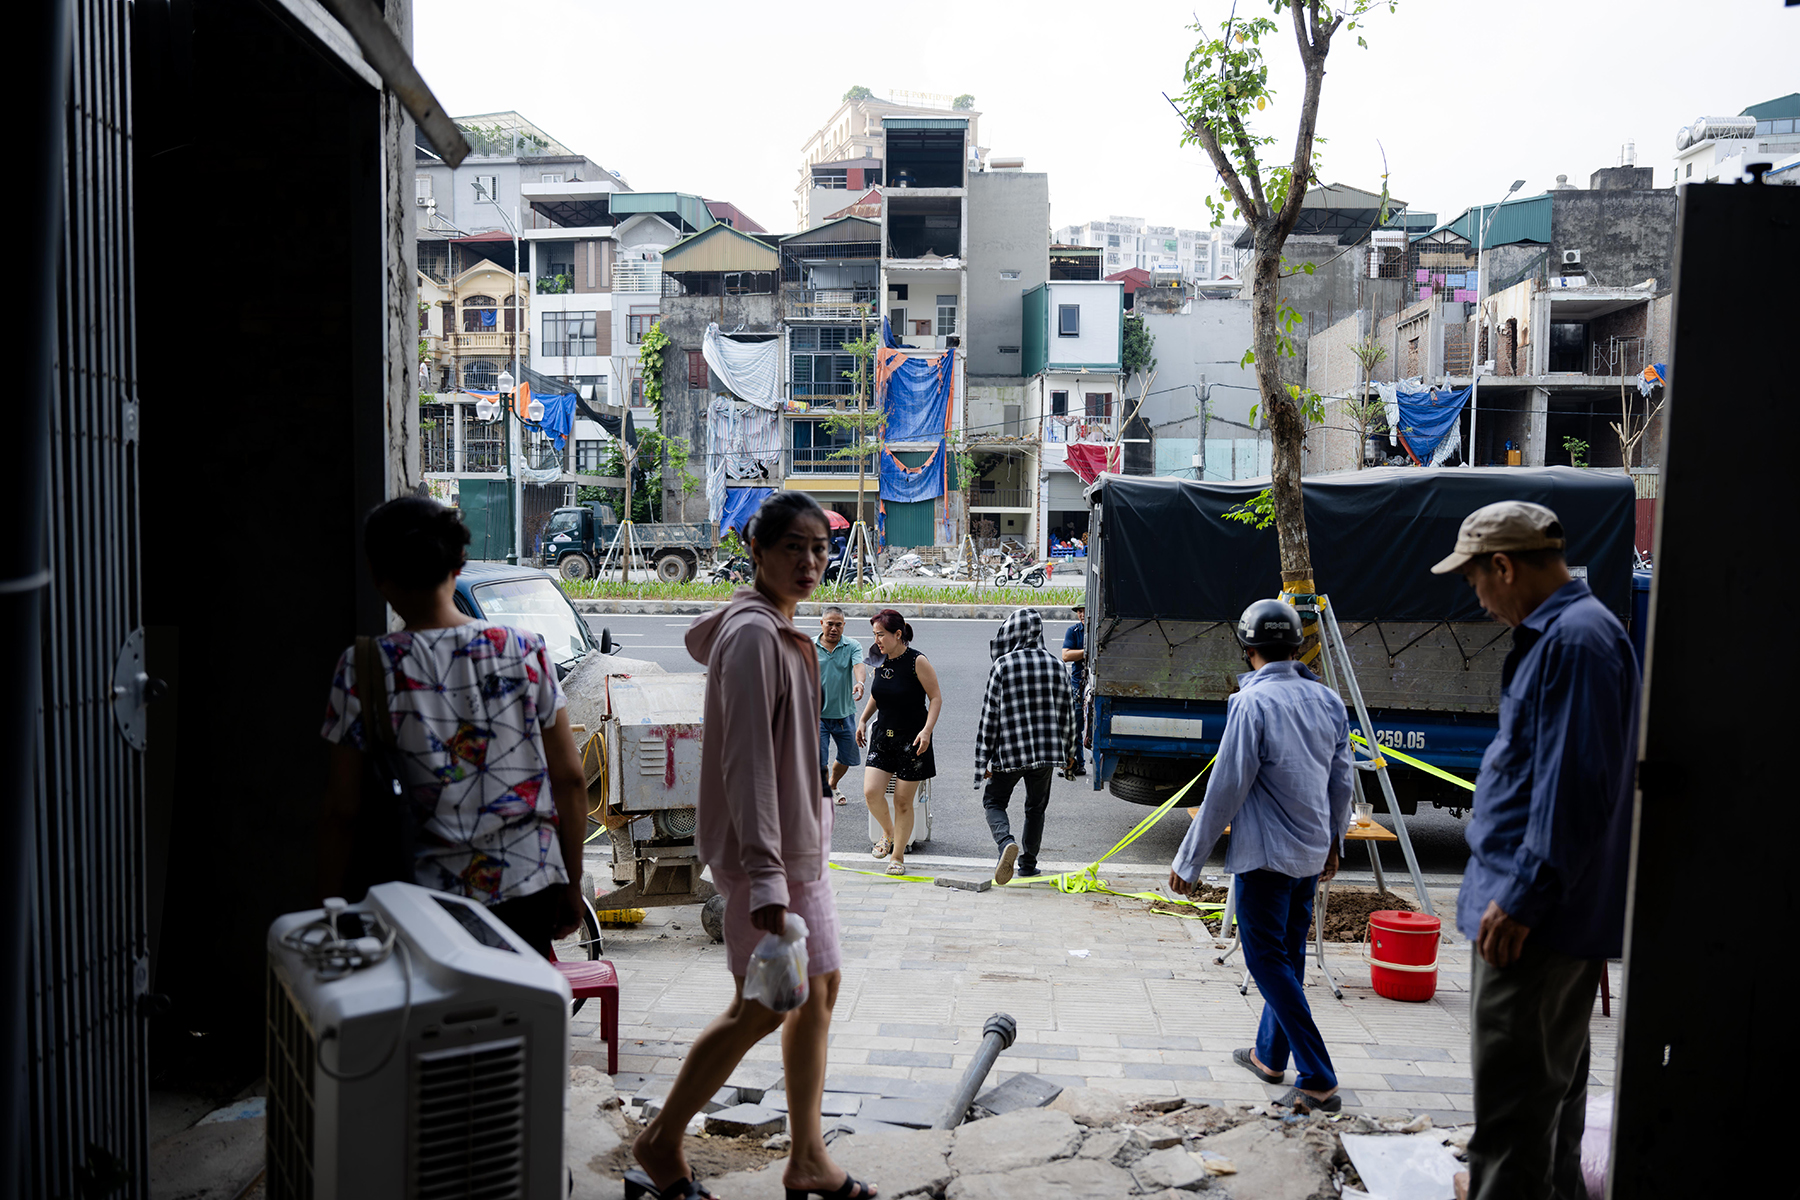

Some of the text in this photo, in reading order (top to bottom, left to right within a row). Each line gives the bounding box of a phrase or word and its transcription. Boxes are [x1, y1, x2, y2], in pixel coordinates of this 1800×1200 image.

[912, 90, 932, 100] PONT
[935, 93, 954, 102] D'OR
[1376, 729, 1425, 749] 259.05
